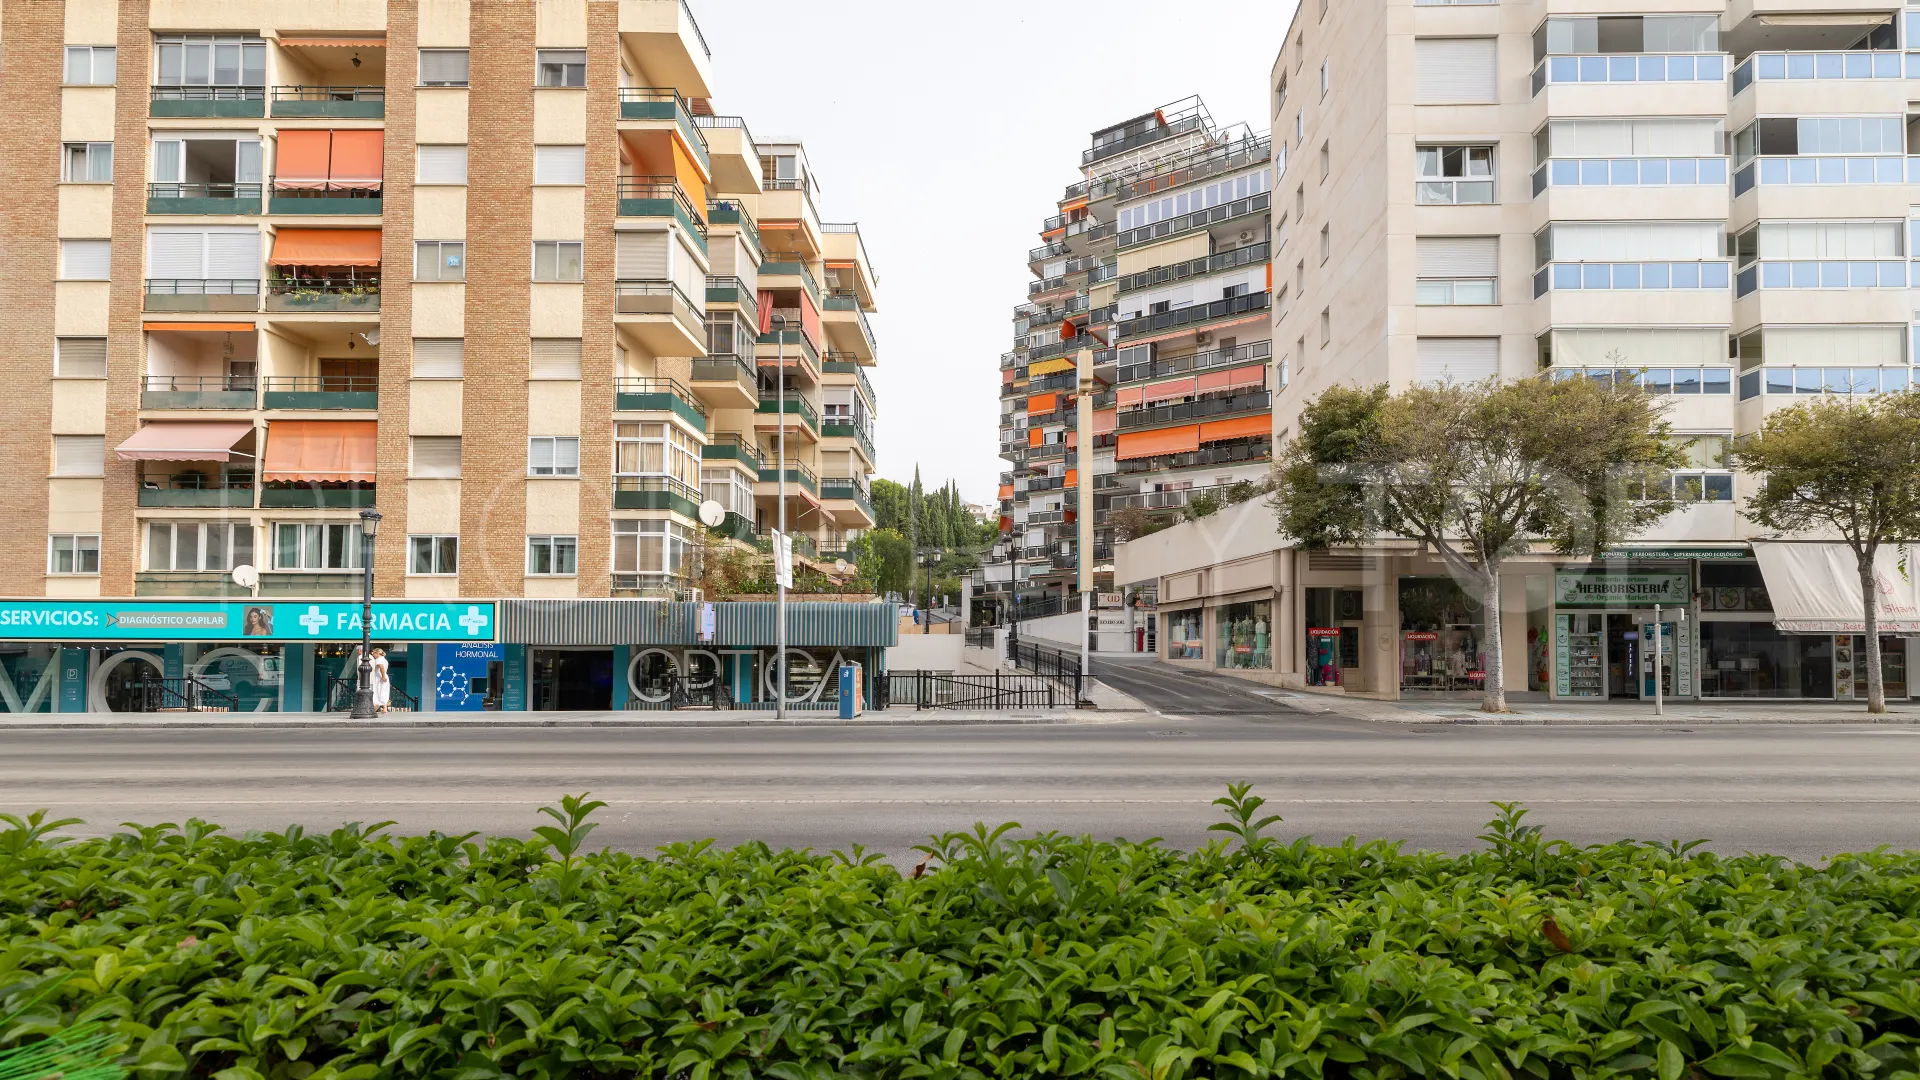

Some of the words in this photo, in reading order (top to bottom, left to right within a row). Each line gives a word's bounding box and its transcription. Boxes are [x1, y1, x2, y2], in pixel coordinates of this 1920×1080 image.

[1579, 583, 1668, 594] HERBORISTERIA
[0, 610, 98, 626] SERVICIOS:
[119, 614, 183, 625] DIAGNÓSTICO
[185, 616, 224, 625] CAPILAR
[337, 613, 451, 630] FARMACIA
[1843, 622, 1897, 631] Restaante
[455, 650, 499, 658] HORMONAL
[627, 648, 866, 703] OPTICA
